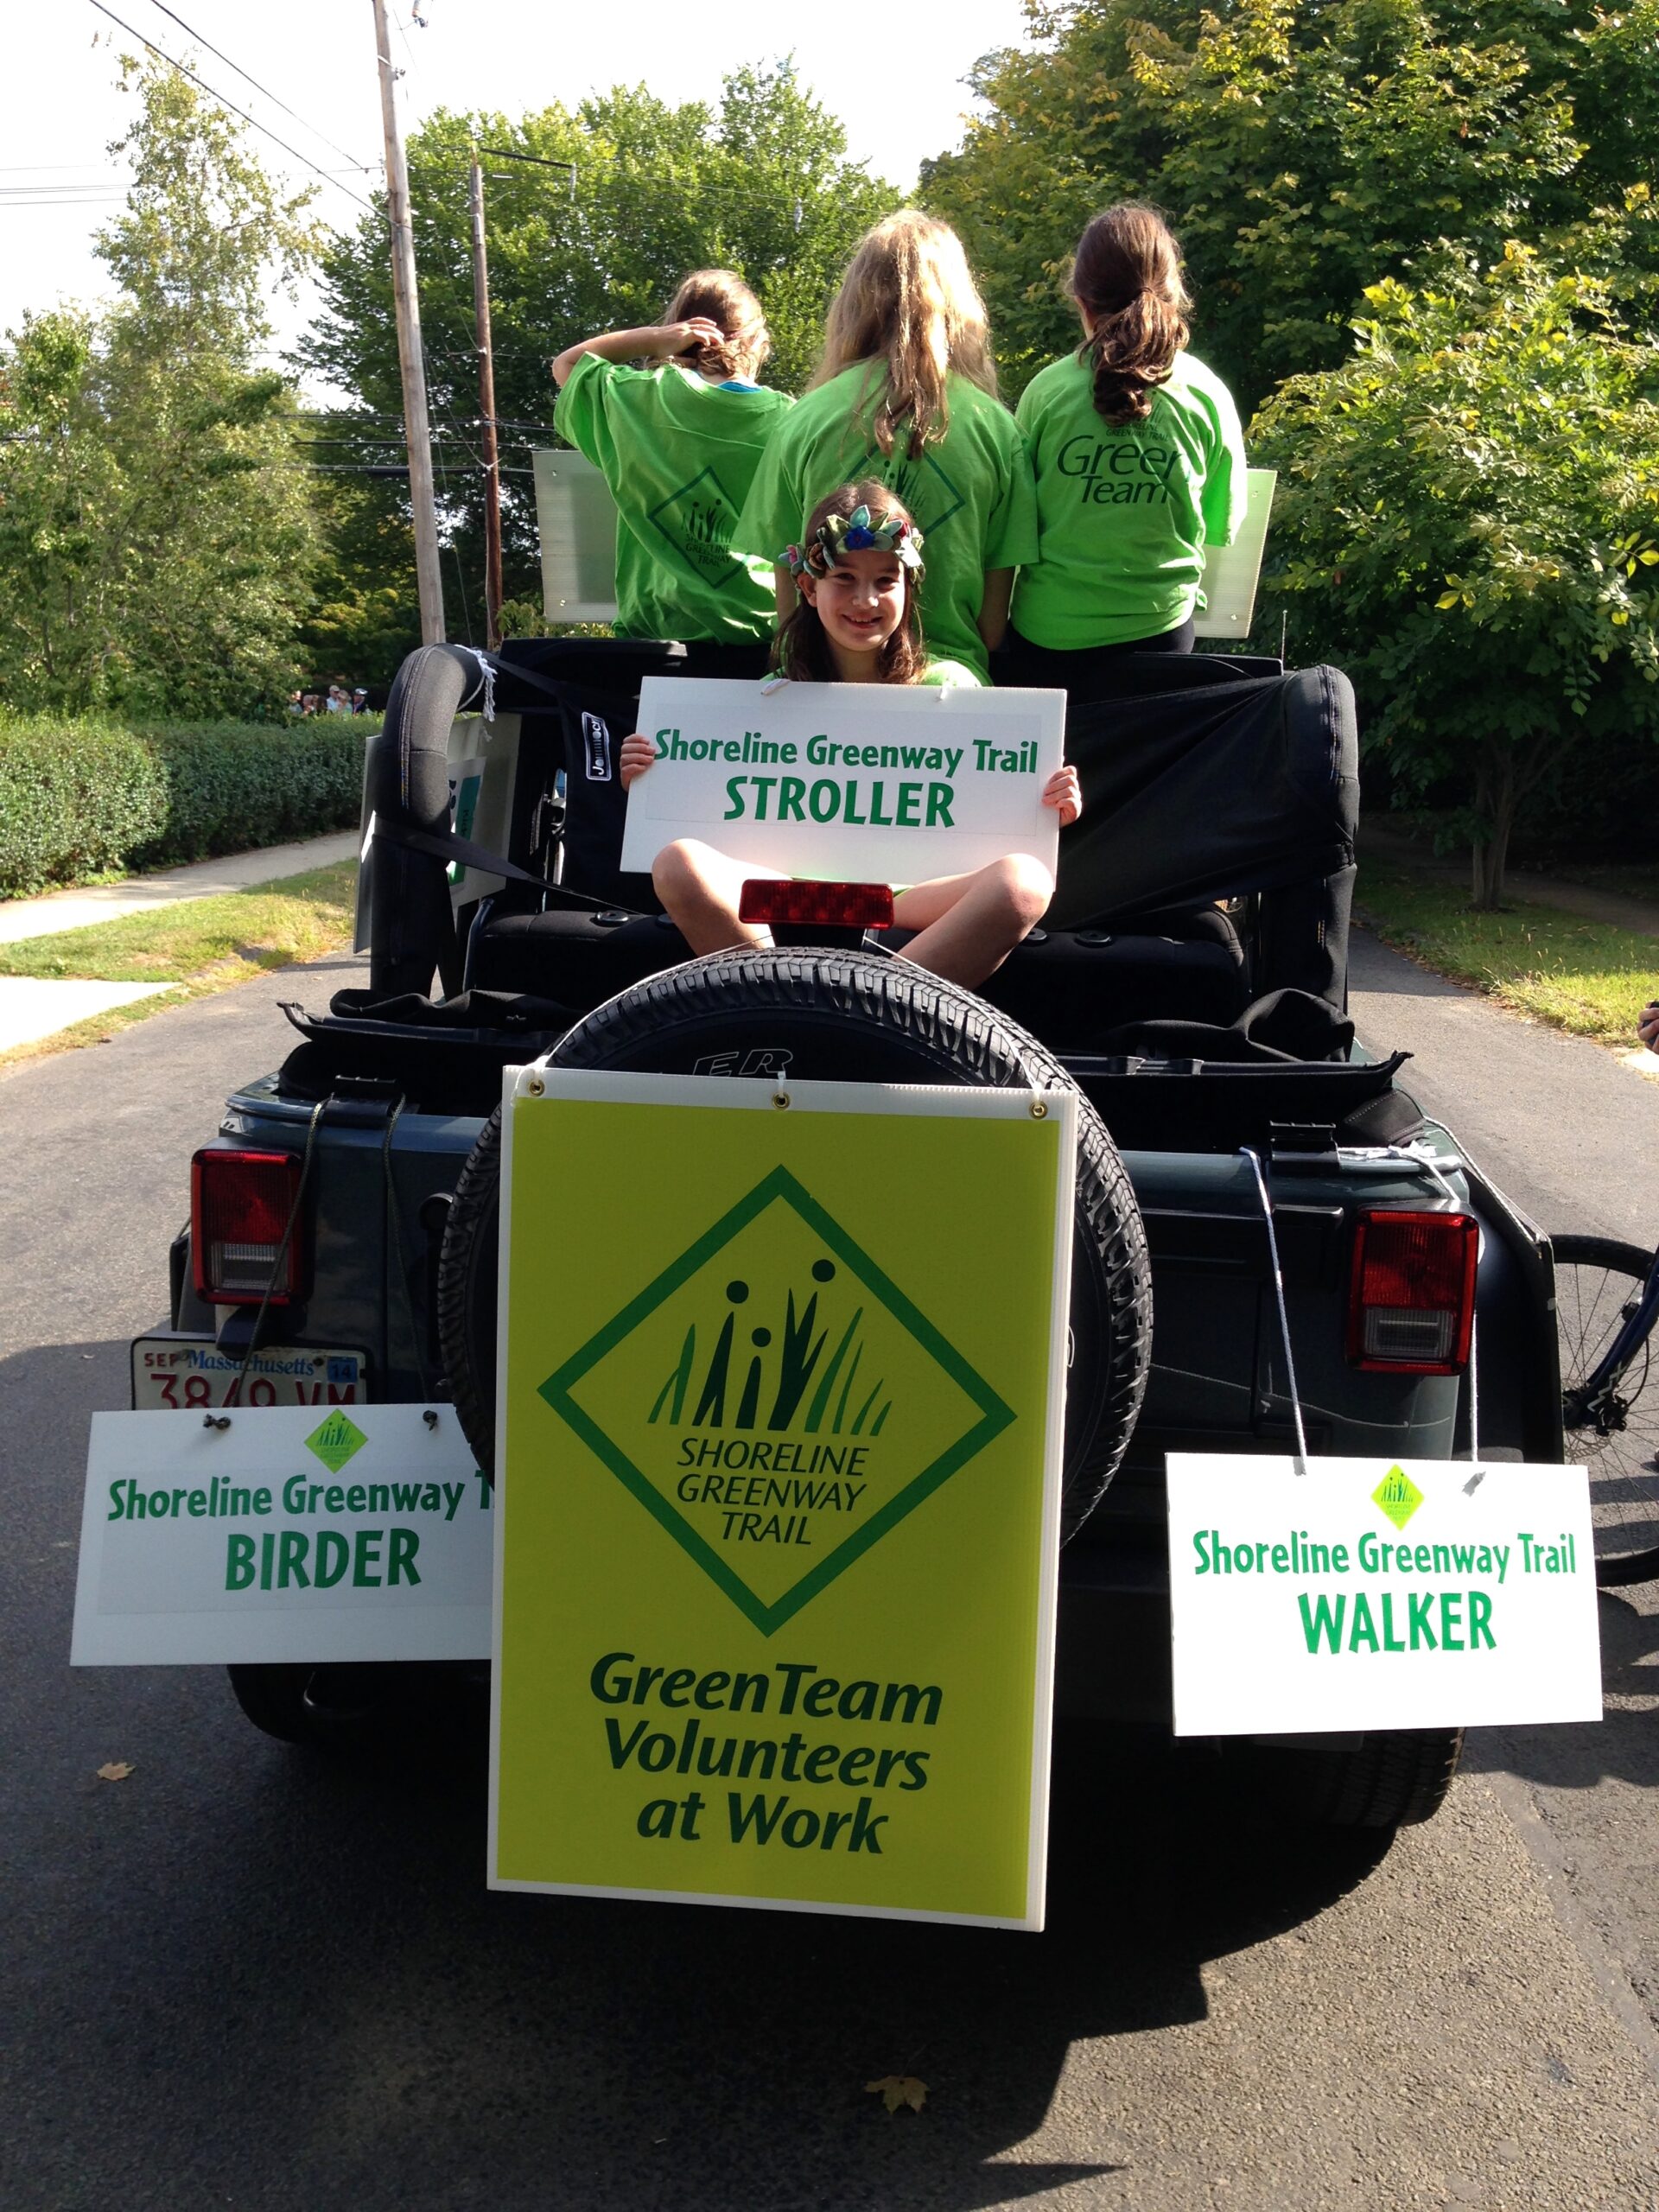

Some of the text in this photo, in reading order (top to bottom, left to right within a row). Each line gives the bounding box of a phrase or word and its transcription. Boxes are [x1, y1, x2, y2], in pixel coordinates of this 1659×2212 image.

[1081, 475, 1167, 504] Team
[655, 728, 1038, 779] Shoreline Greenway Trail
[724, 776, 955, 828] STROLLER
[331, 1363, 353, 1377] 14
[677, 1437, 870, 1477] SHORELINE
[108, 1476, 272, 1521] Shoreline
[283, 1474, 466, 1522] Greenway
[677, 1473, 868, 1512] GREENWAY
[721, 1511, 811, 1546] TRAIL
[225, 1528, 423, 1591] BIRDER
[1193, 1530, 1576, 1583] Shoreline Greenway Trail
[1298, 1591, 1497, 1654] WALKER
[604, 1718, 931, 1791] Volunteers
[637, 1791, 890, 1855] at Work
